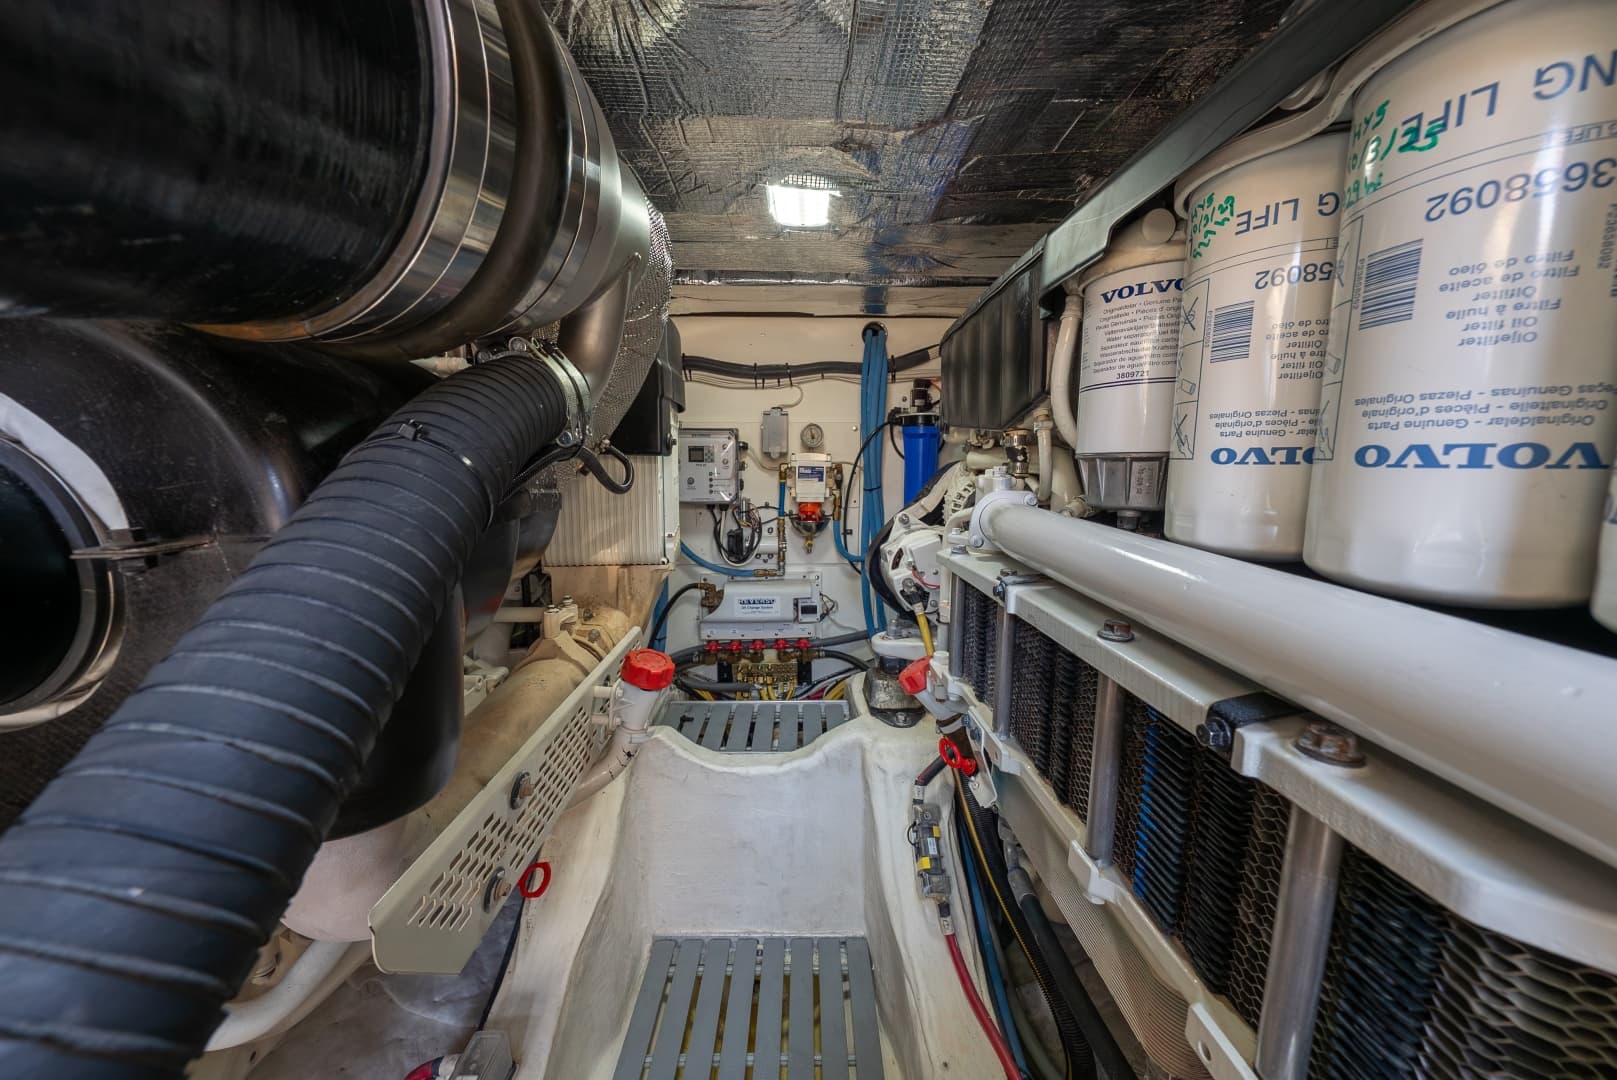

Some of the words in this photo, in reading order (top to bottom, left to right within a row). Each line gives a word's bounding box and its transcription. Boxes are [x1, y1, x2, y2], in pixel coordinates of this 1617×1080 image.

[1533, 49, 1617, 101] NG
[1401, 81, 1500, 145] LIFE
[1425, 157, 1617, 223] 3658092
[1234, 198, 1301, 236] LIFE
[1448, 262, 1488, 277] óleo
[1495, 257, 1519, 269] de
[1254, 262, 1334, 290] 58092
[1501, 271, 1525, 283] de
[1529, 265, 1581, 279] Filtro
[1438, 276, 1493, 293] aceite
[1512, 298, 1561, 311] Filtre
[1445, 307, 1489, 321] huile
[1298, 319, 1312, 327] de
[1461, 319, 1505, 332] filter
[1511, 316, 1538, 329] Oil
[1301, 330, 1316, 338] de
[1457, 331, 1538, 347] Oljefilter
[1310, 350, 1327, 358] ltre
[1280, 362, 1305, 370] filter
[1309, 361, 1324, 370] Oil
[1277, 369, 1324, 380] Oljefilter
[1420, 390, 1473, 402] Piezas
[1490, 385, 1573, 399] Genuinas
[1354, 394, 1415, 408] Originales
[1509, 398, 1609, 412] Originalteile
[1209, 410, 1252, 420] Originales
[1255, 409, 1288, 418] Piezas
[1362, 406, 1430, 419] d'originale
[1435, 403, 1490, 417] Pièces
[1265, 419, 1298, 428] Pièces
[1367, 421, 1400, 432] Parts
[1404, 418, 1469, 430] Genuine
[1486, 414, 1595, 428] Originaldelar
[1220, 430, 1243, 438] Parts
[1245, 429, 1286, 438] Genuine
[1211, 446, 1314, 465] LVO
[1354, 442, 1609, 469] VOLVO
